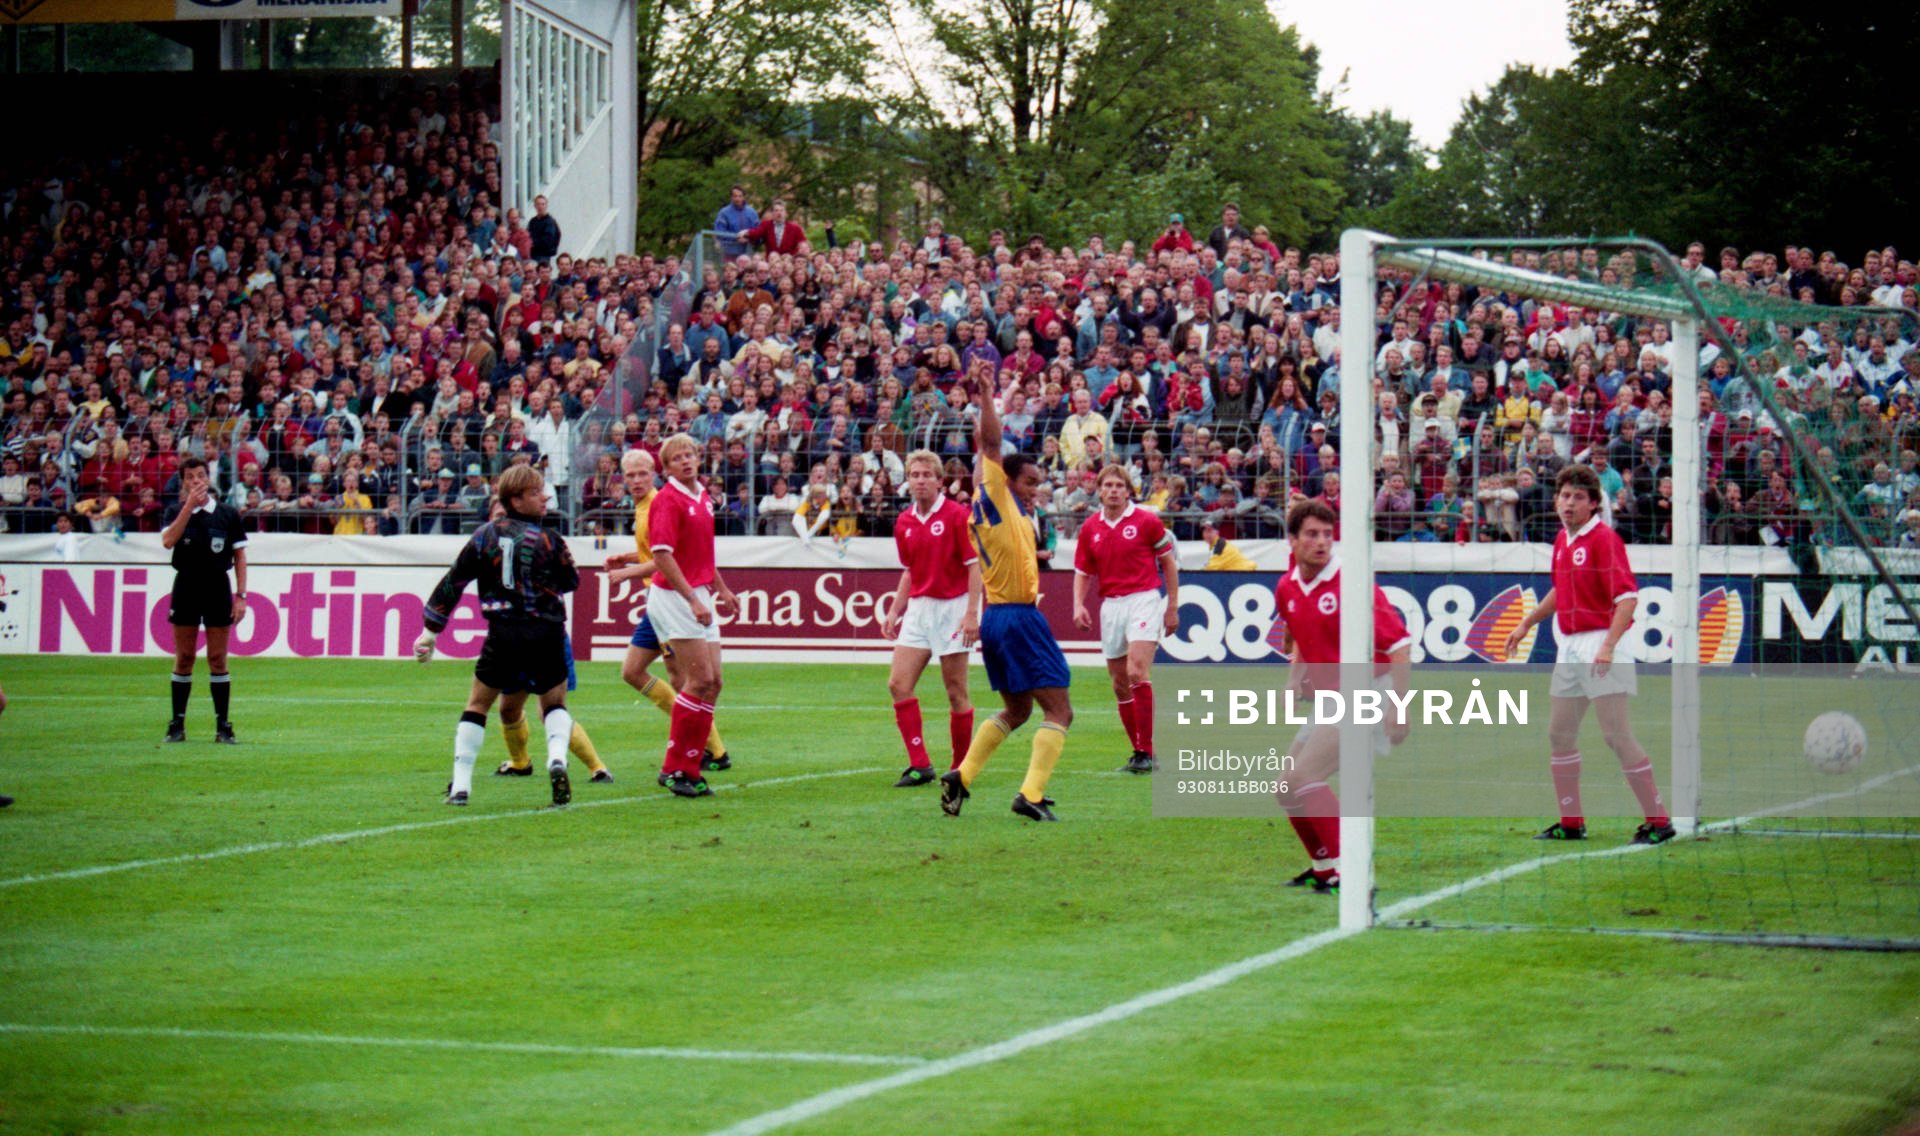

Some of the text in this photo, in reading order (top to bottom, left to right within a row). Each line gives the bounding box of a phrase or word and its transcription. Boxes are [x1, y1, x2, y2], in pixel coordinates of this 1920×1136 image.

[498, 536, 515, 590] 1
[592, 571, 804, 626] Paena
[1159, 583, 1276, 662] Q8
